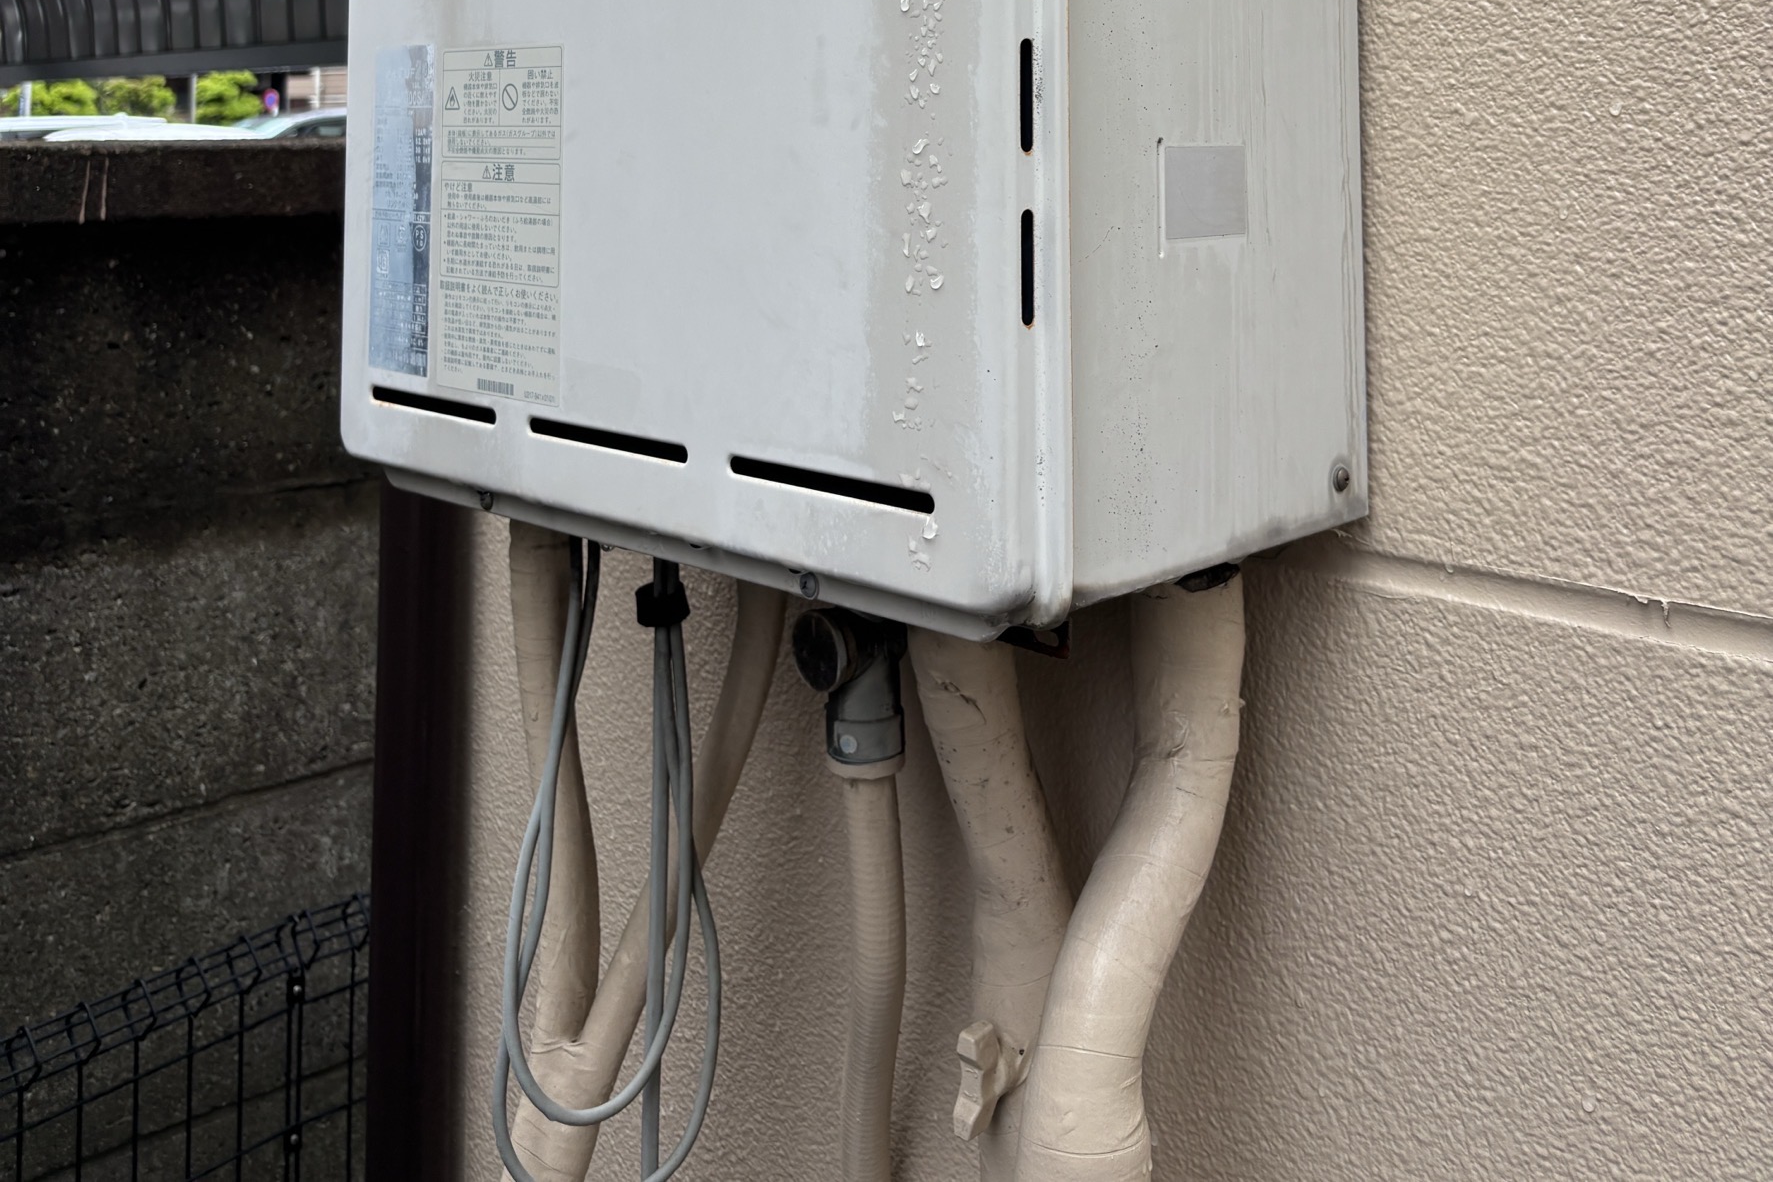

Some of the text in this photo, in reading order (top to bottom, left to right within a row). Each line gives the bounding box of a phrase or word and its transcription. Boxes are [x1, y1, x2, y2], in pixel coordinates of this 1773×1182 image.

[494, 50, 516, 68] 警告
[469, 71, 492, 82] 火災注意
[528, 70, 553, 79] 囲い禁止
[493, 164, 515, 181] 注意
[445, 182, 472, 192] やけど注意
